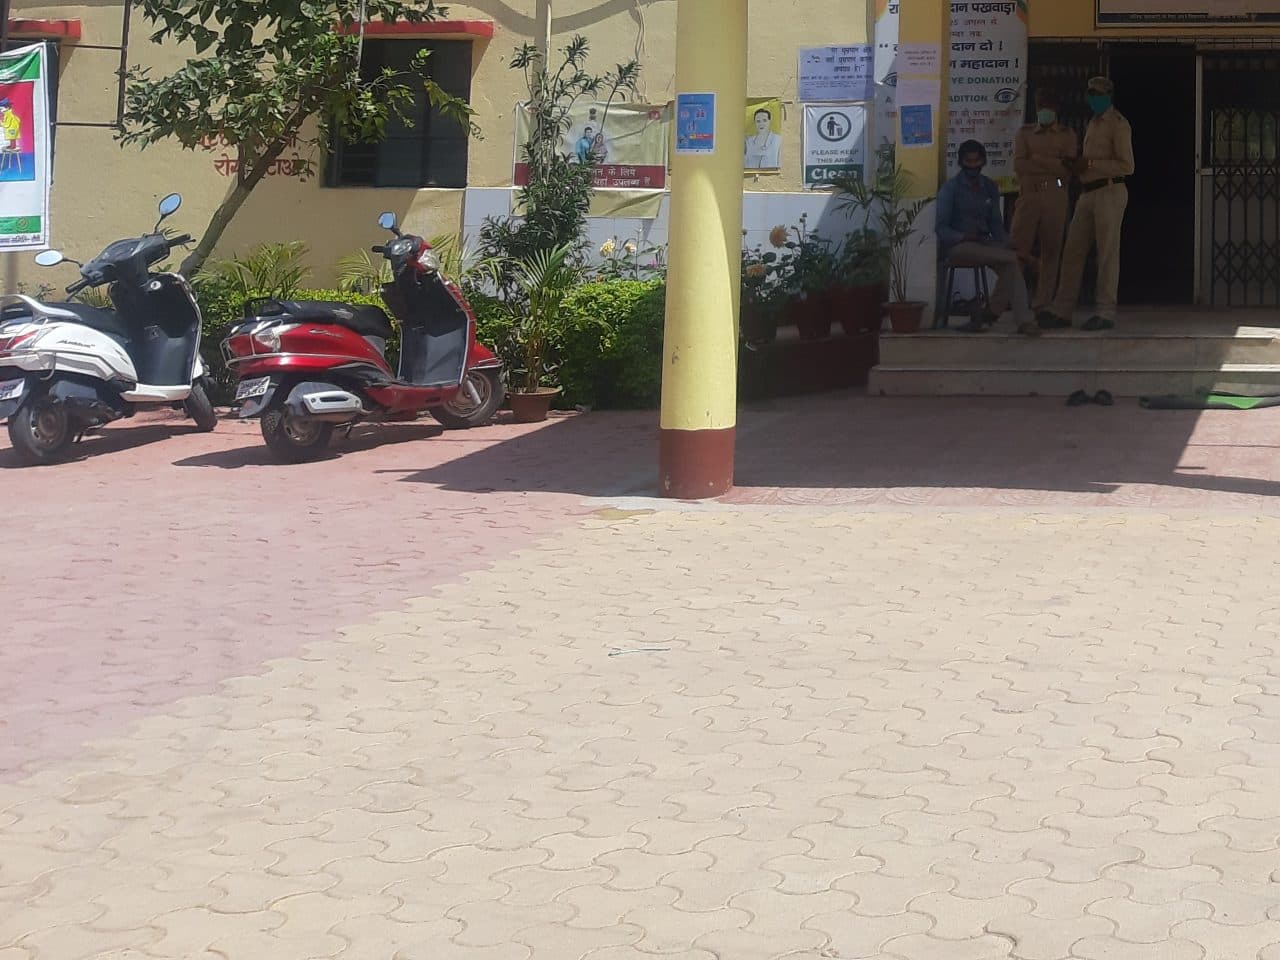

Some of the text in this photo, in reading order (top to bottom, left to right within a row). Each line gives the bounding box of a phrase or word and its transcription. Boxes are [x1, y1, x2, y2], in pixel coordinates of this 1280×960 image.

[967, 76, 1020, 84] DONATION
[950, 94, 988, 102] ADITION
[811, 168, 858, 180] Clean
